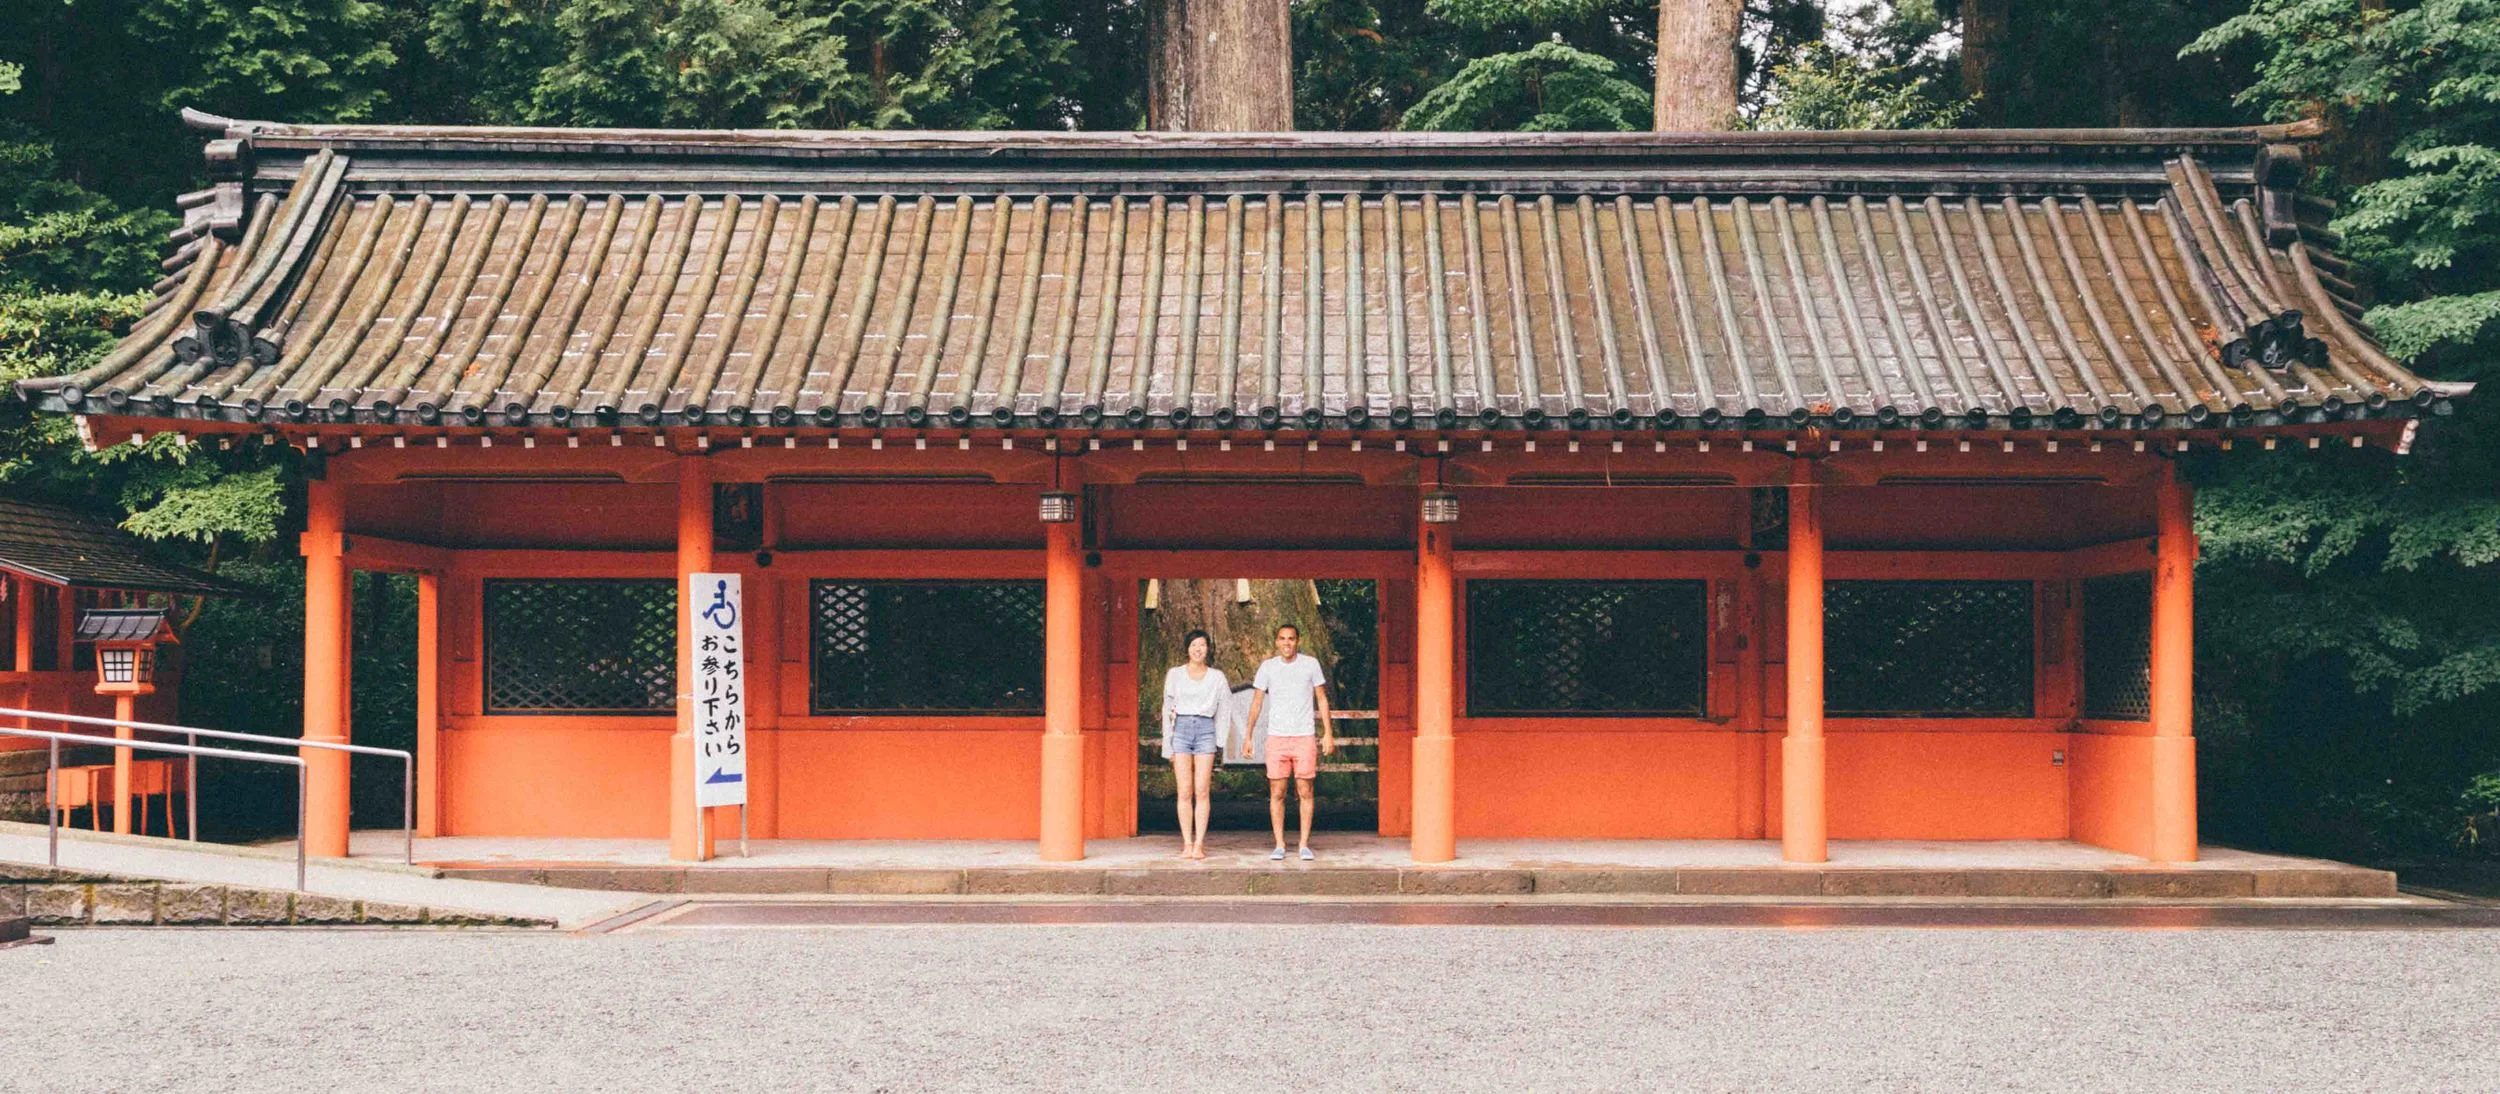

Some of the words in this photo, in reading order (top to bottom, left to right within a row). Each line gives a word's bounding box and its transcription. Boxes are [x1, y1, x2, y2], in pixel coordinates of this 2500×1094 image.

[701, 635, 721, 757] お参り下さい
[723, 635, 740, 755] こちらから
